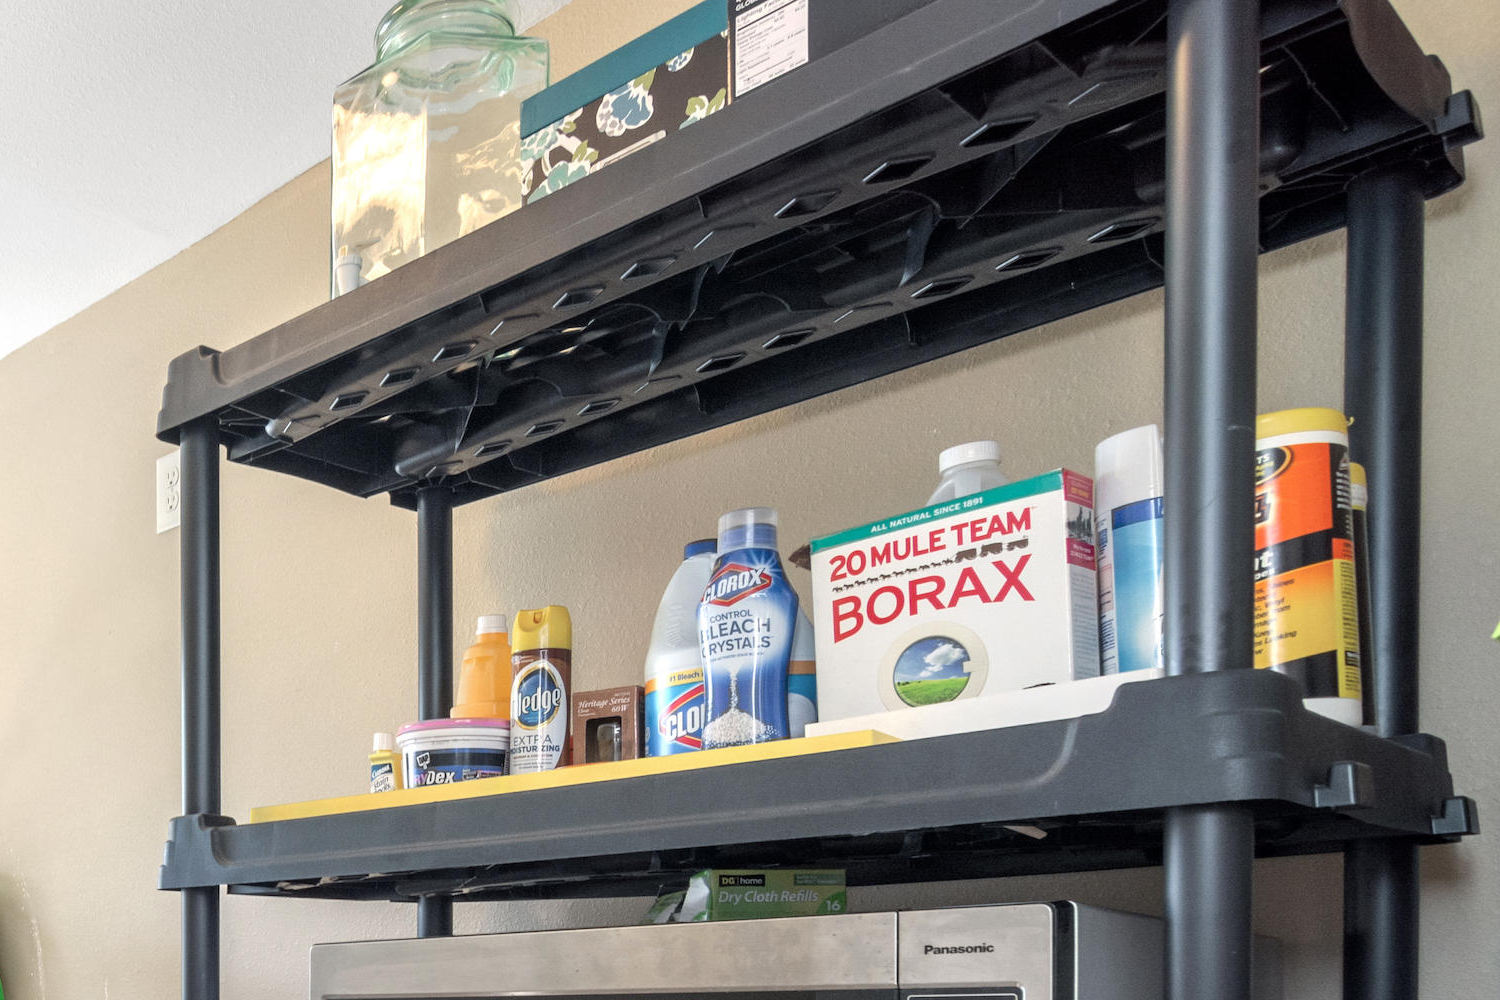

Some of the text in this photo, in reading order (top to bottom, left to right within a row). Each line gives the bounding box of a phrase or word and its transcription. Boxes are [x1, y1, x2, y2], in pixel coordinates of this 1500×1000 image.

[870, 496, 983, 533] ALL NATURAL SINCE 1891
[829, 507, 1032, 582] 20 MULE TEAM
[703, 568, 765, 605] CLOROX
[832, 553, 1036, 644] BORAX
[709, 609, 753, 623] CONTROL
[677, 671, 700, 681] Bleach
[579, 696, 630, 709] Heritage Series
[722, 876, 762, 885] DG home
[719, 889, 819, 904] Dry Cloth Refills
[826, 900, 841, 911] 16
[924, 943, 994, 955] Panasonic
